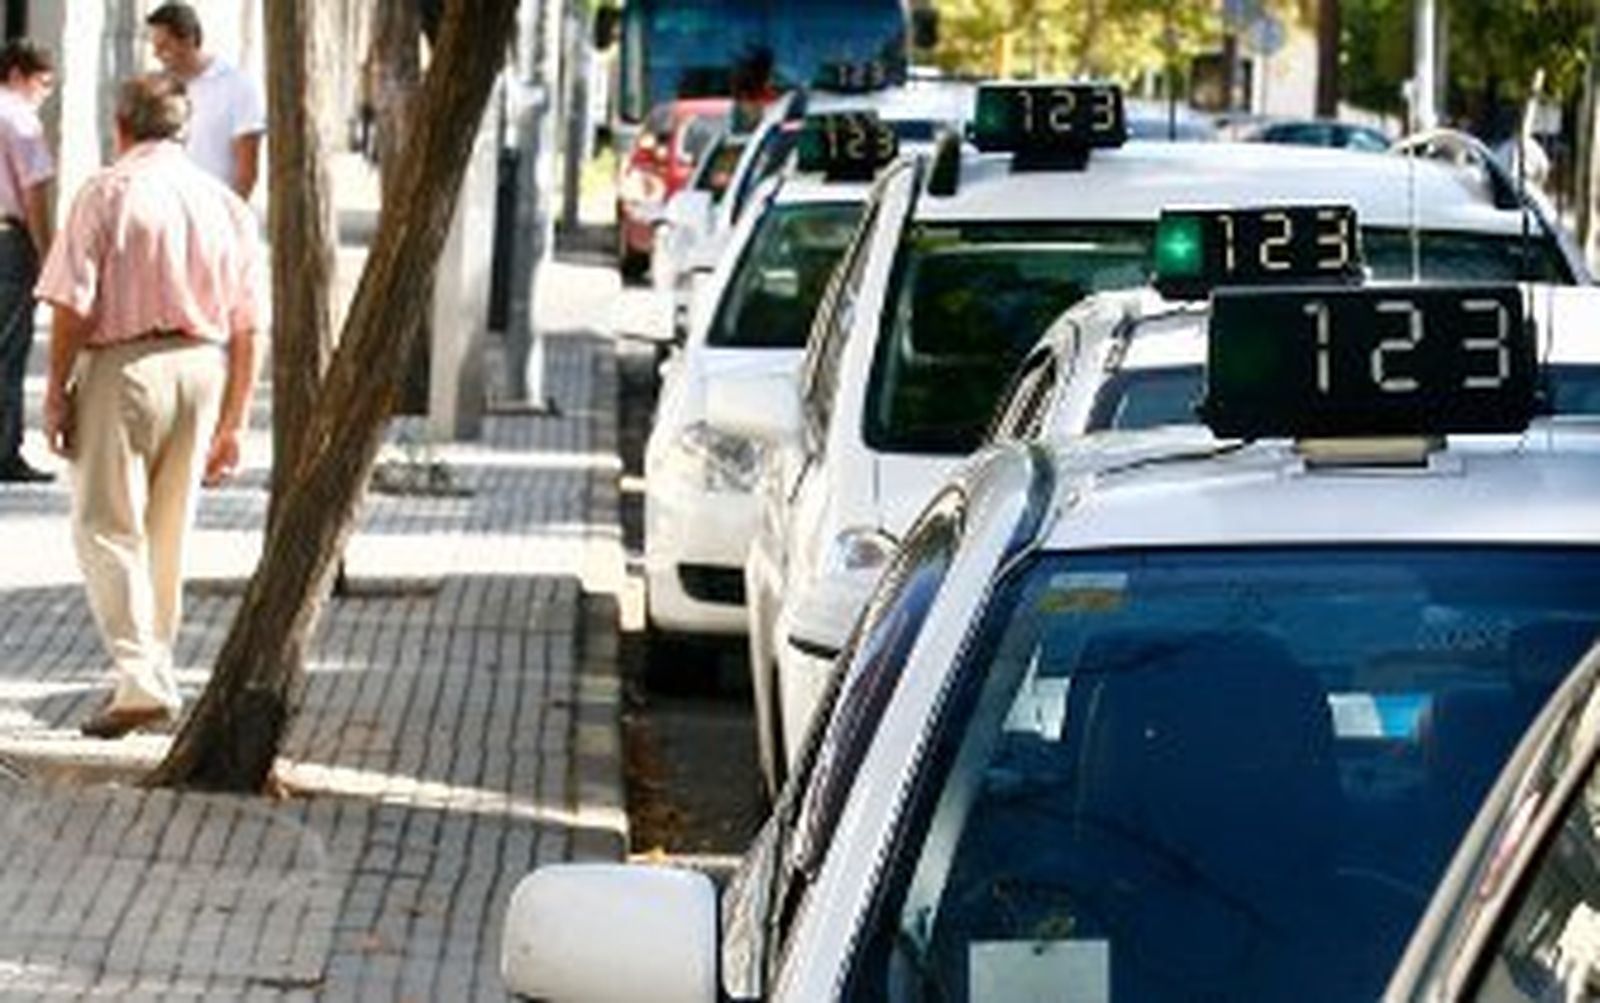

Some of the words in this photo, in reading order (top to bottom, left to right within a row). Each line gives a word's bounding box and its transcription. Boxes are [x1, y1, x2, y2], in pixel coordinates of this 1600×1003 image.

[1018, 90, 1115, 131] 123
[828, 126, 894, 159] 123
[1218, 211, 1349, 270] 123
[1303, 299, 1509, 393] 123
